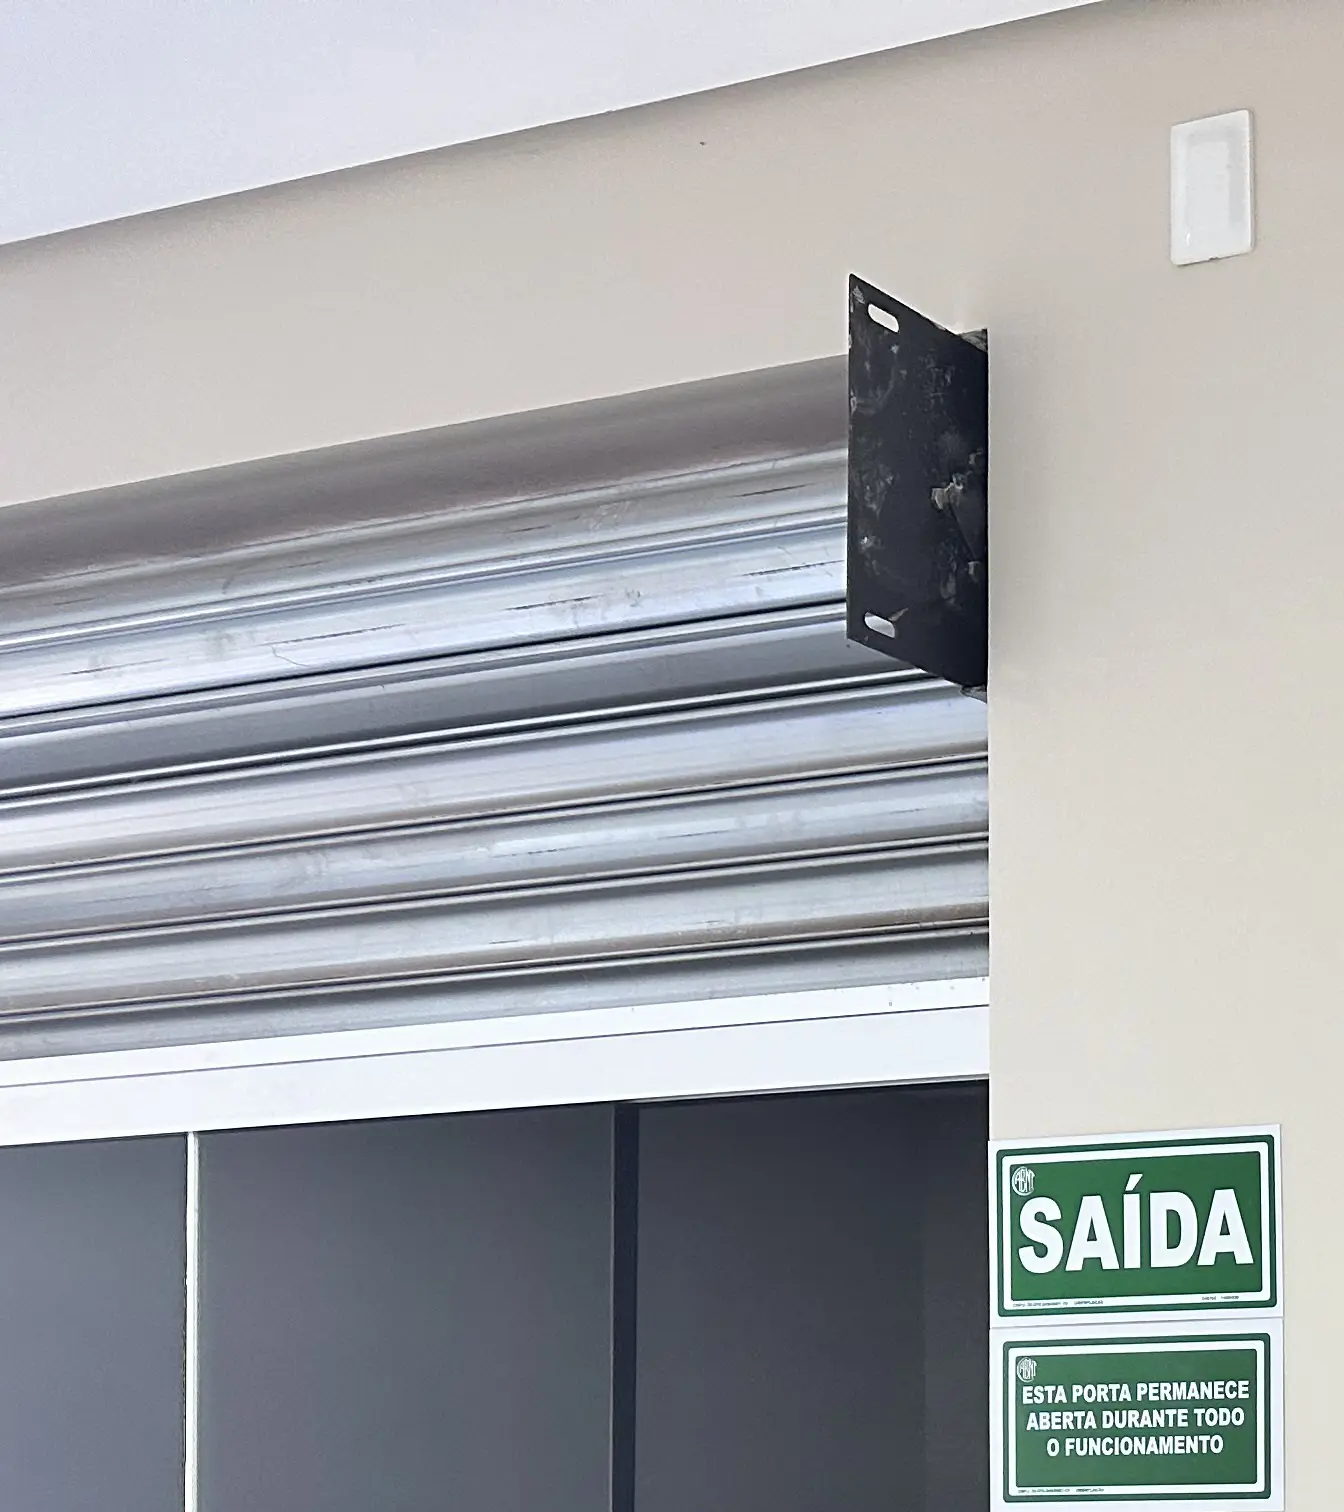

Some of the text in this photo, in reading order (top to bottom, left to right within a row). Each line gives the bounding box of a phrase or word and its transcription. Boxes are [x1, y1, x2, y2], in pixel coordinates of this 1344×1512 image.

[1018, 1174, 1254, 1274] SAÍDA
[1023, 1381, 1249, 1404] ESTA PORTA PERMANECE
[1027, 1408, 1244, 1430] ABERTA DURANTE TODO
[1047, 1435, 1223, 1456] O FUNCIONAMENTO
